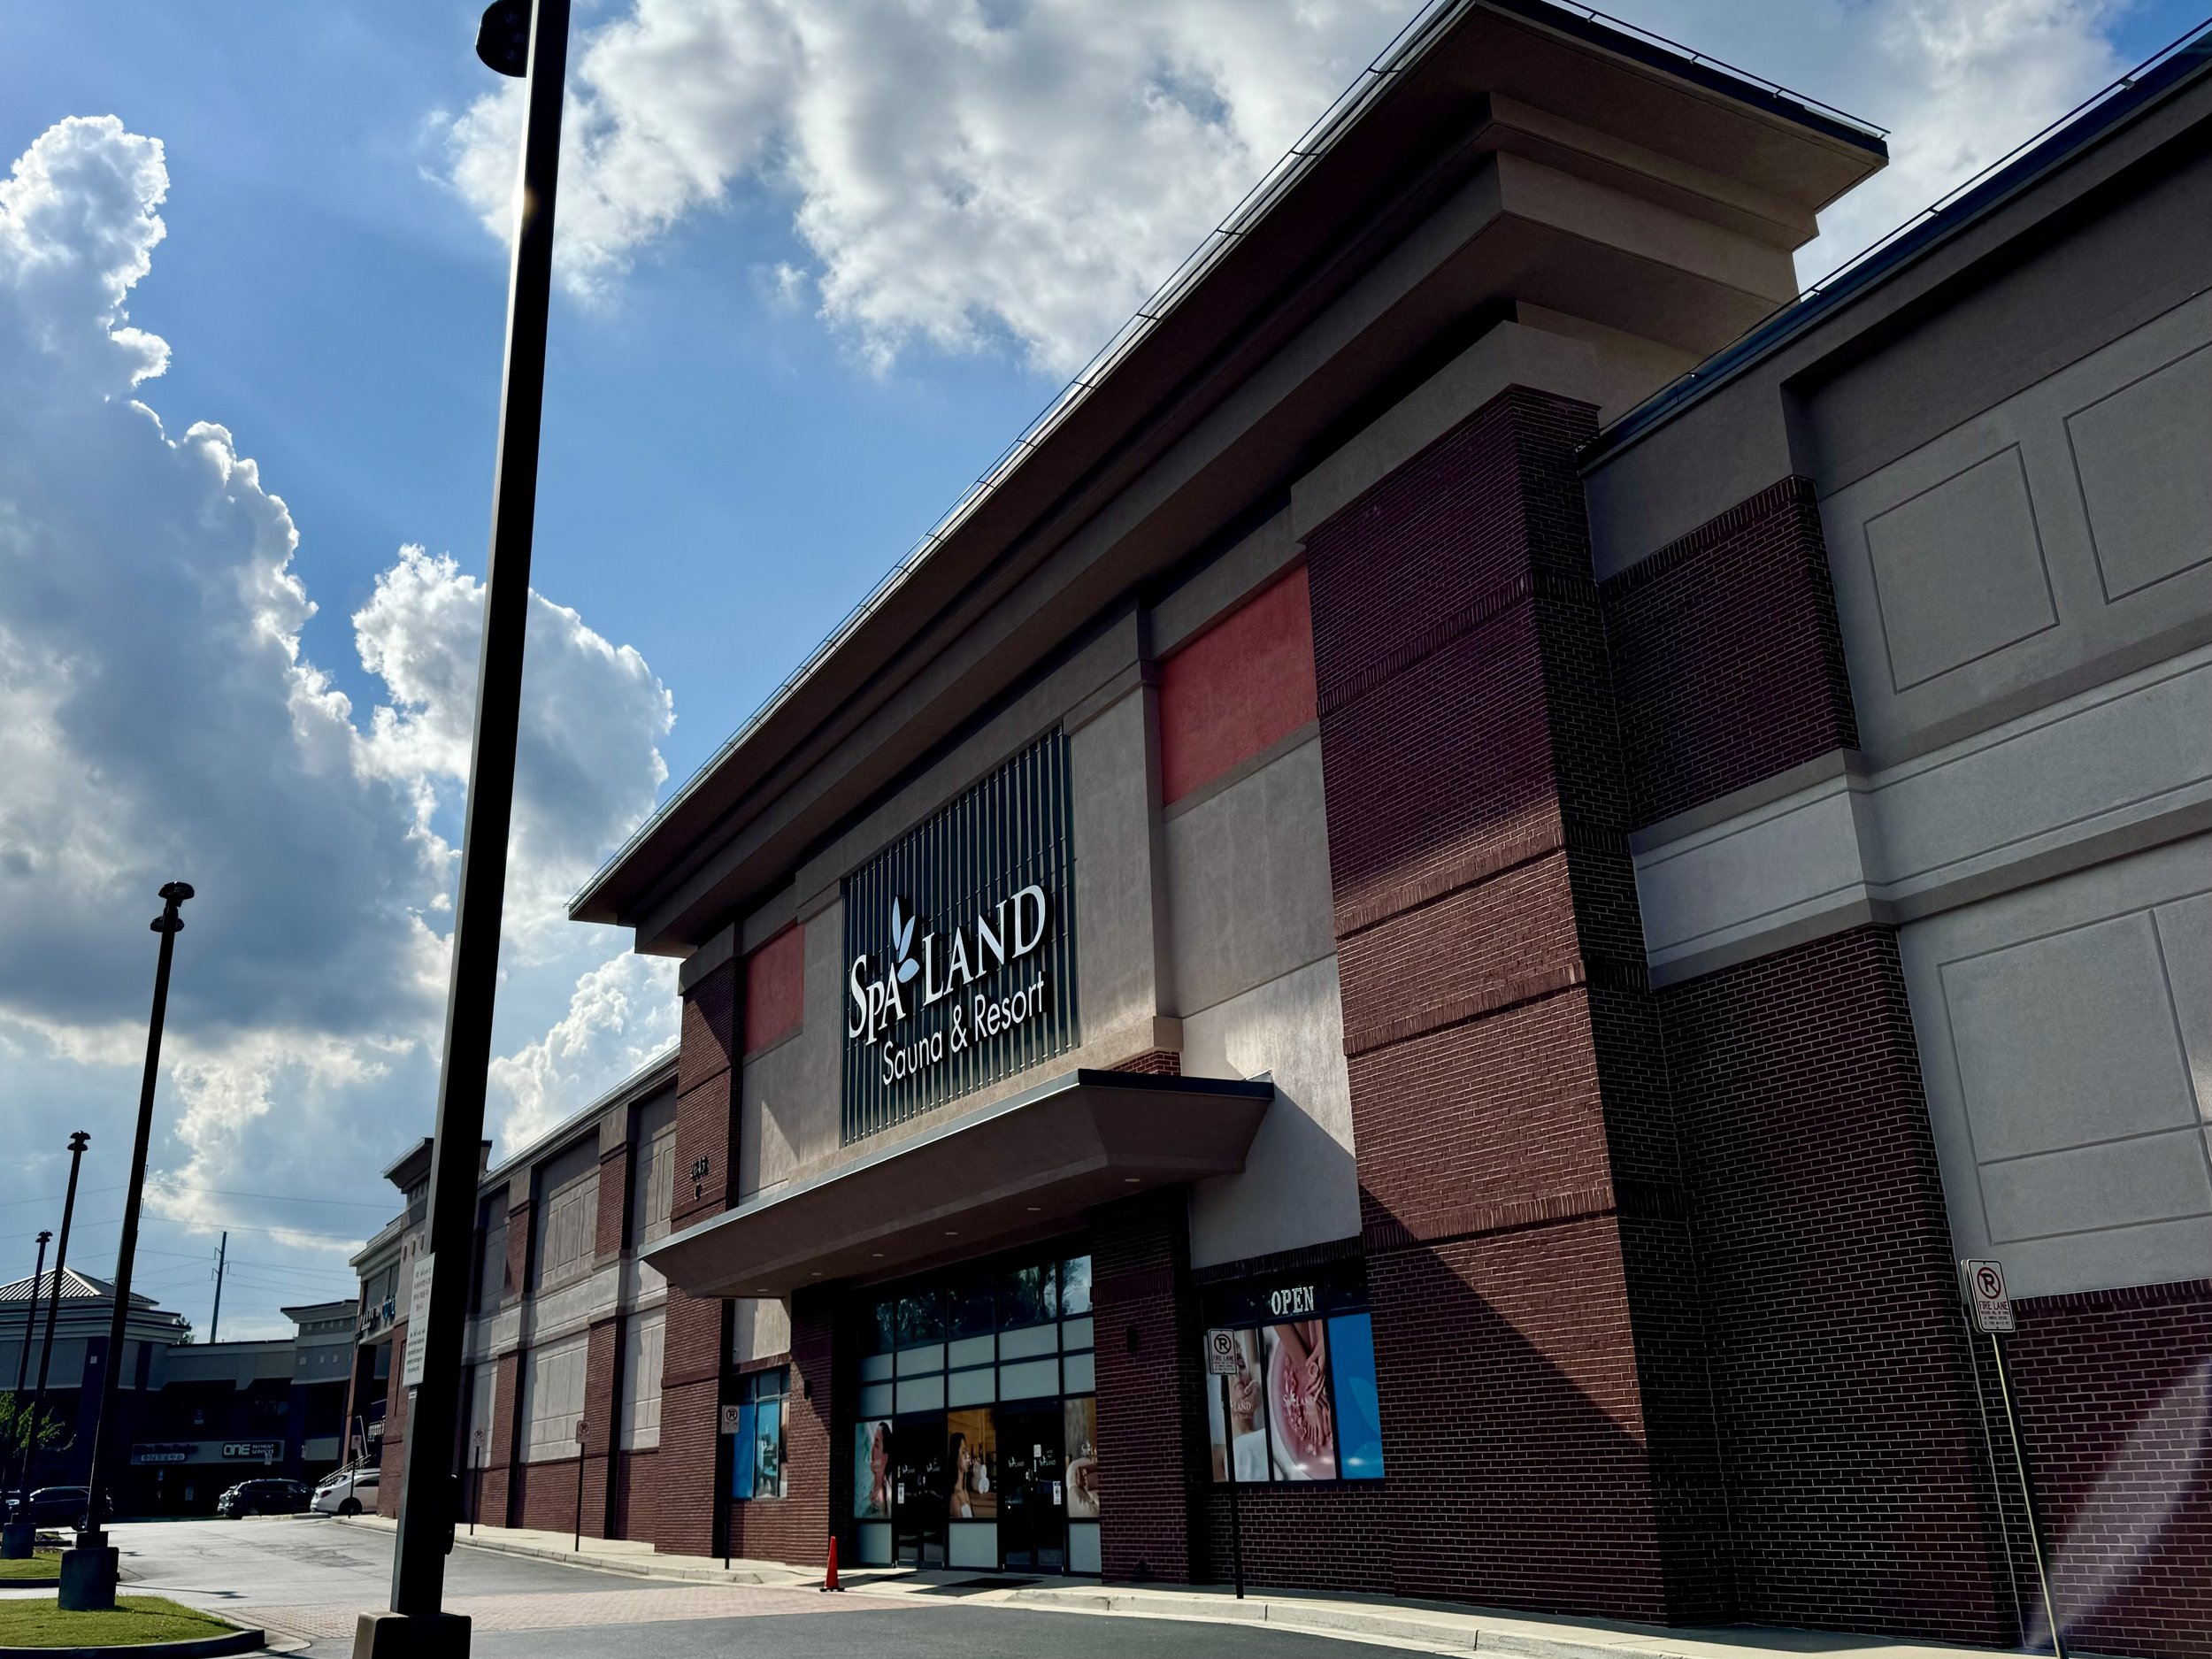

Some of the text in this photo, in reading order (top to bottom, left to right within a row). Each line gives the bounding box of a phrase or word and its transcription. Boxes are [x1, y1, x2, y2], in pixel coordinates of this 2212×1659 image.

[849, 885, 1046, 1046] SPA LAND
[883, 971, 1045, 1086] Sauna & Resort
[1271, 1286, 1315, 1316] OPEN
[1978, 1302, 2008, 1310] FIRE LANE
[1233, 1402, 1252, 1412] LAND
[224, 1444, 250, 1455] ONE
